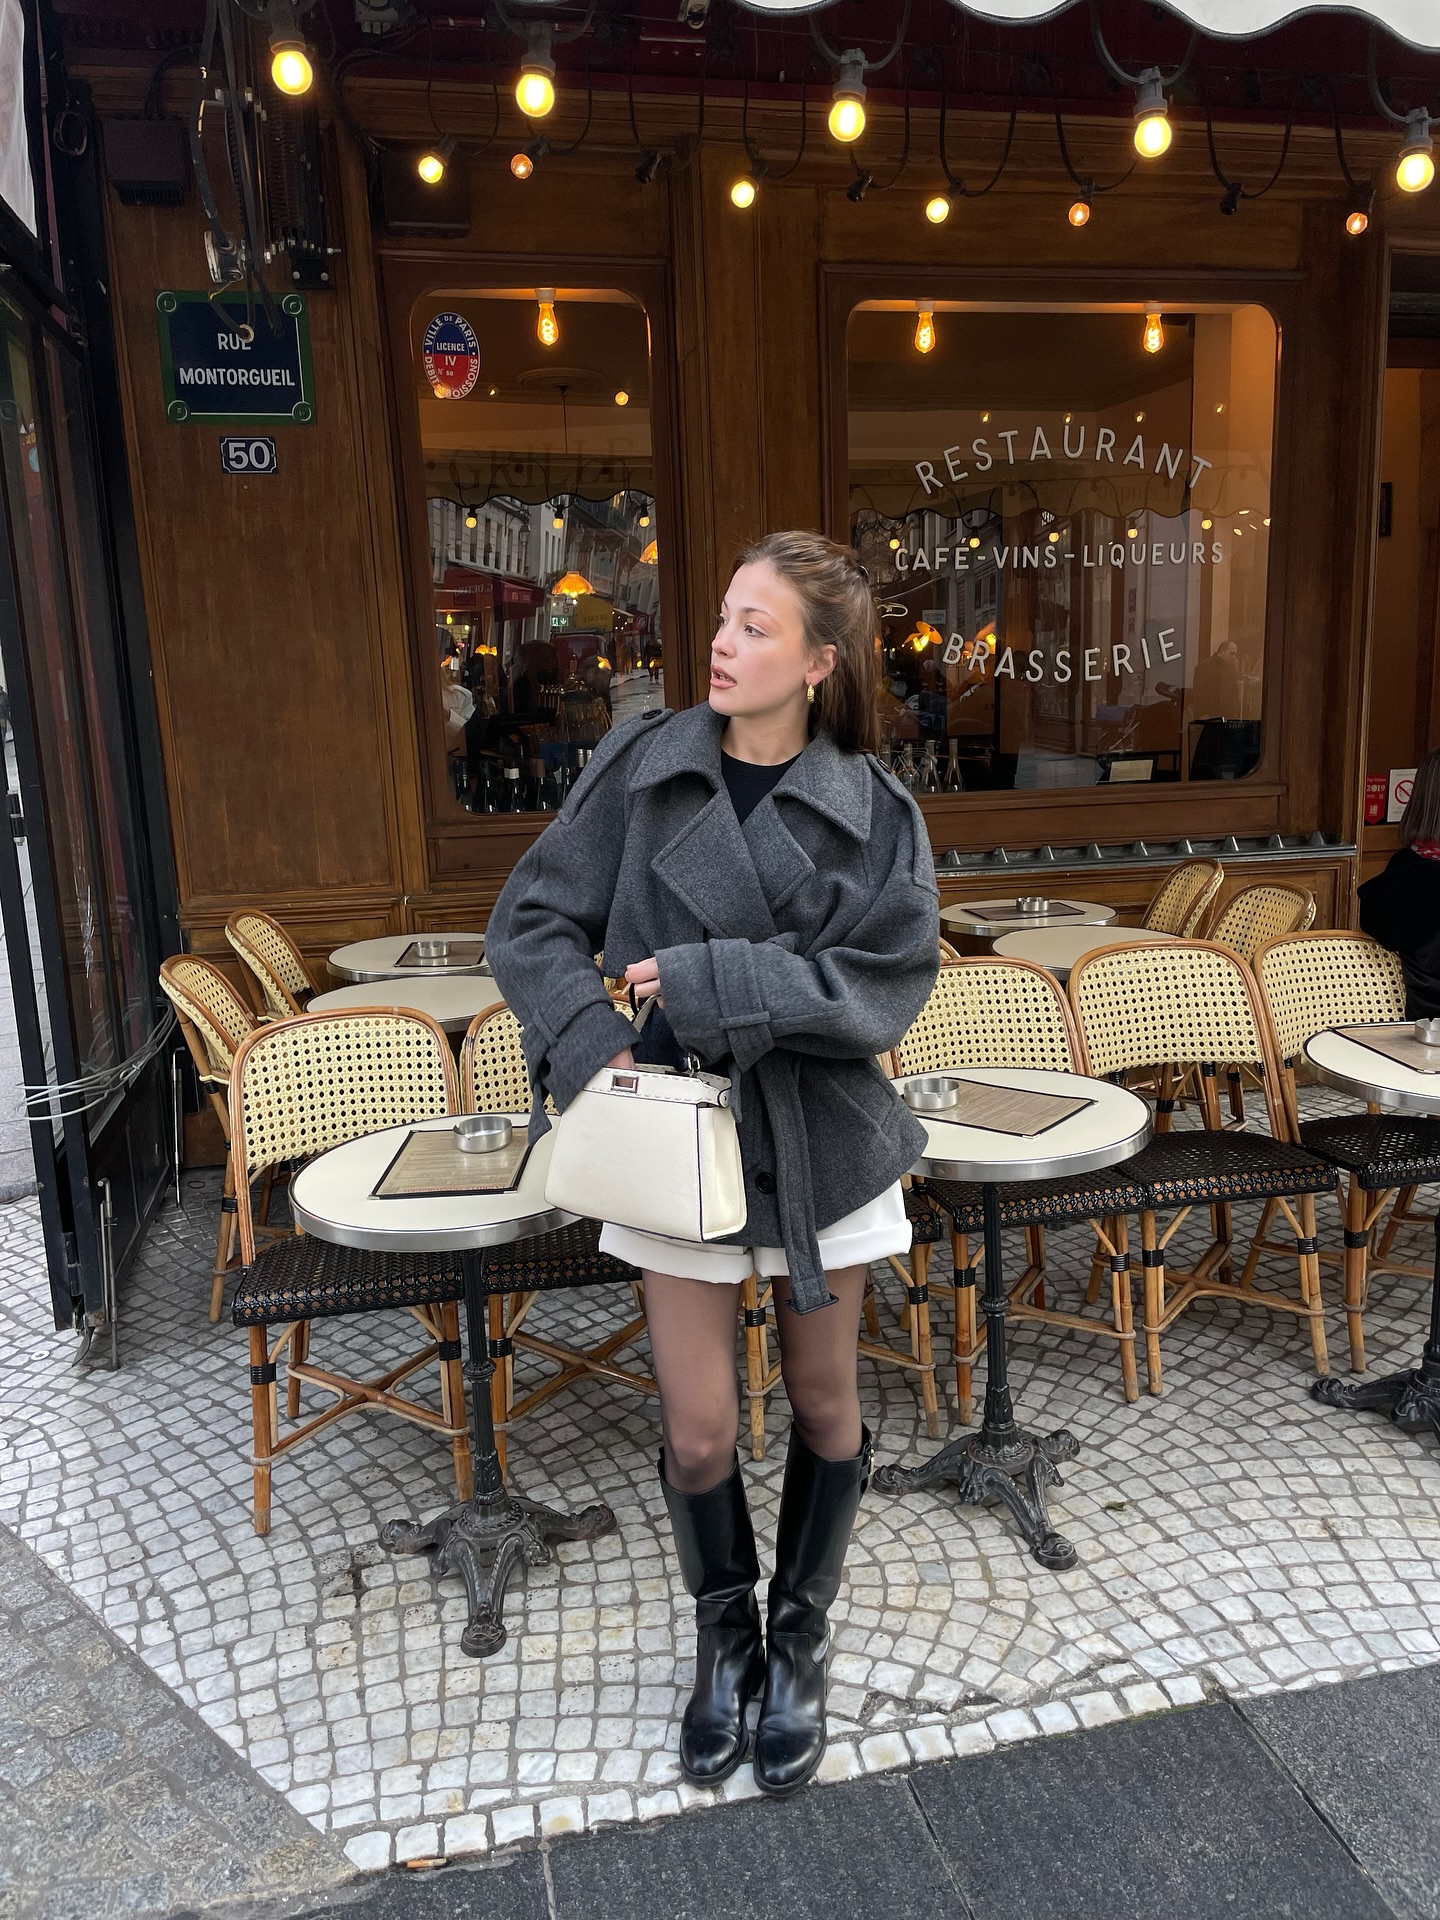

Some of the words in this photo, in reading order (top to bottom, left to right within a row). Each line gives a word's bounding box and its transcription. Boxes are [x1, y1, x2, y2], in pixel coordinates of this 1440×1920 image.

[424, 317, 443, 346] VILLE
[454, 317, 477, 348] PARIS
[436, 342, 465, 352] LICENCE
[445, 355, 457, 366] IV
[179, 367, 296, 387] MONTORGUEIL
[424, 356, 440, 384] DEBIT
[445, 358, 478, 398] BOISSONS
[228, 441, 271, 470] 50
[914, 425, 1213, 495] RESTAURANT
[942, 627, 1182, 683] BRASSERIE
[1366, 784, 1386, 793] 2019
